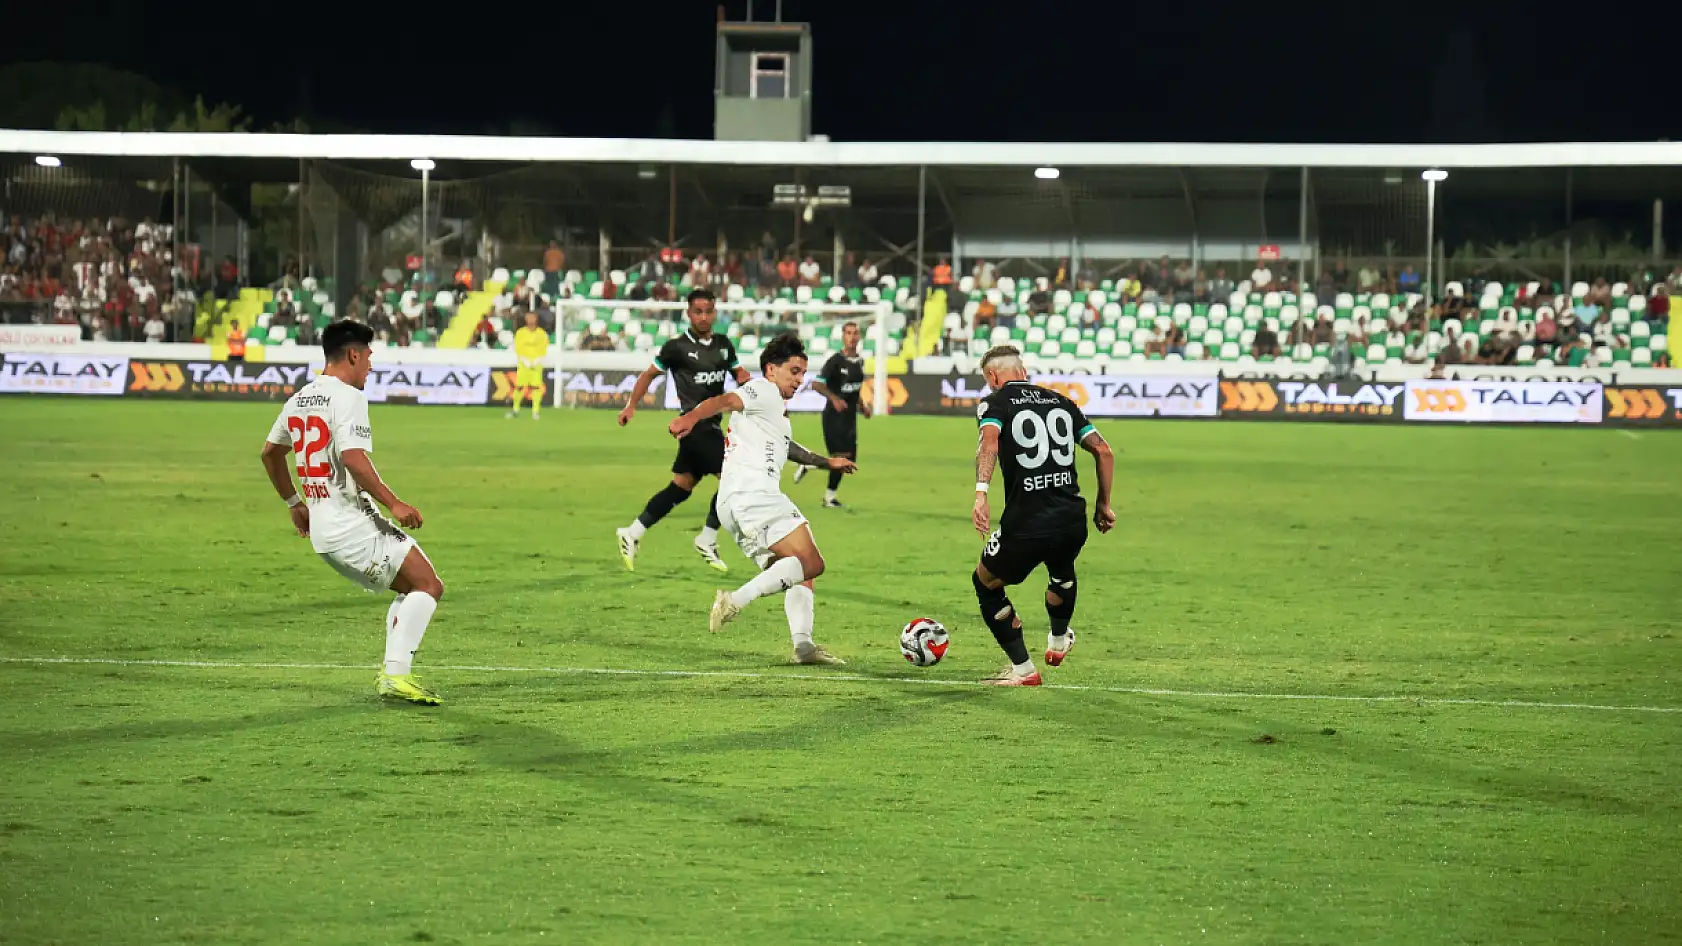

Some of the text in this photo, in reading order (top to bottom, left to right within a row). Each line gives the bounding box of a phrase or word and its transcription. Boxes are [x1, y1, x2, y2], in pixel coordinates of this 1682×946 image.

[5, 360, 122, 378] TALAY
[187, 363, 306, 385] TALAY
[371, 370, 484, 388] TALAY
[1094, 382, 1212, 398] TALAY
[1277, 381, 1404, 405] TALAY
[1472, 388, 1596, 406] TALAY
[287, 415, 332, 478] 22
[1011, 408, 1075, 469] 99
[1023, 471, 1072, 492] SEFERI
